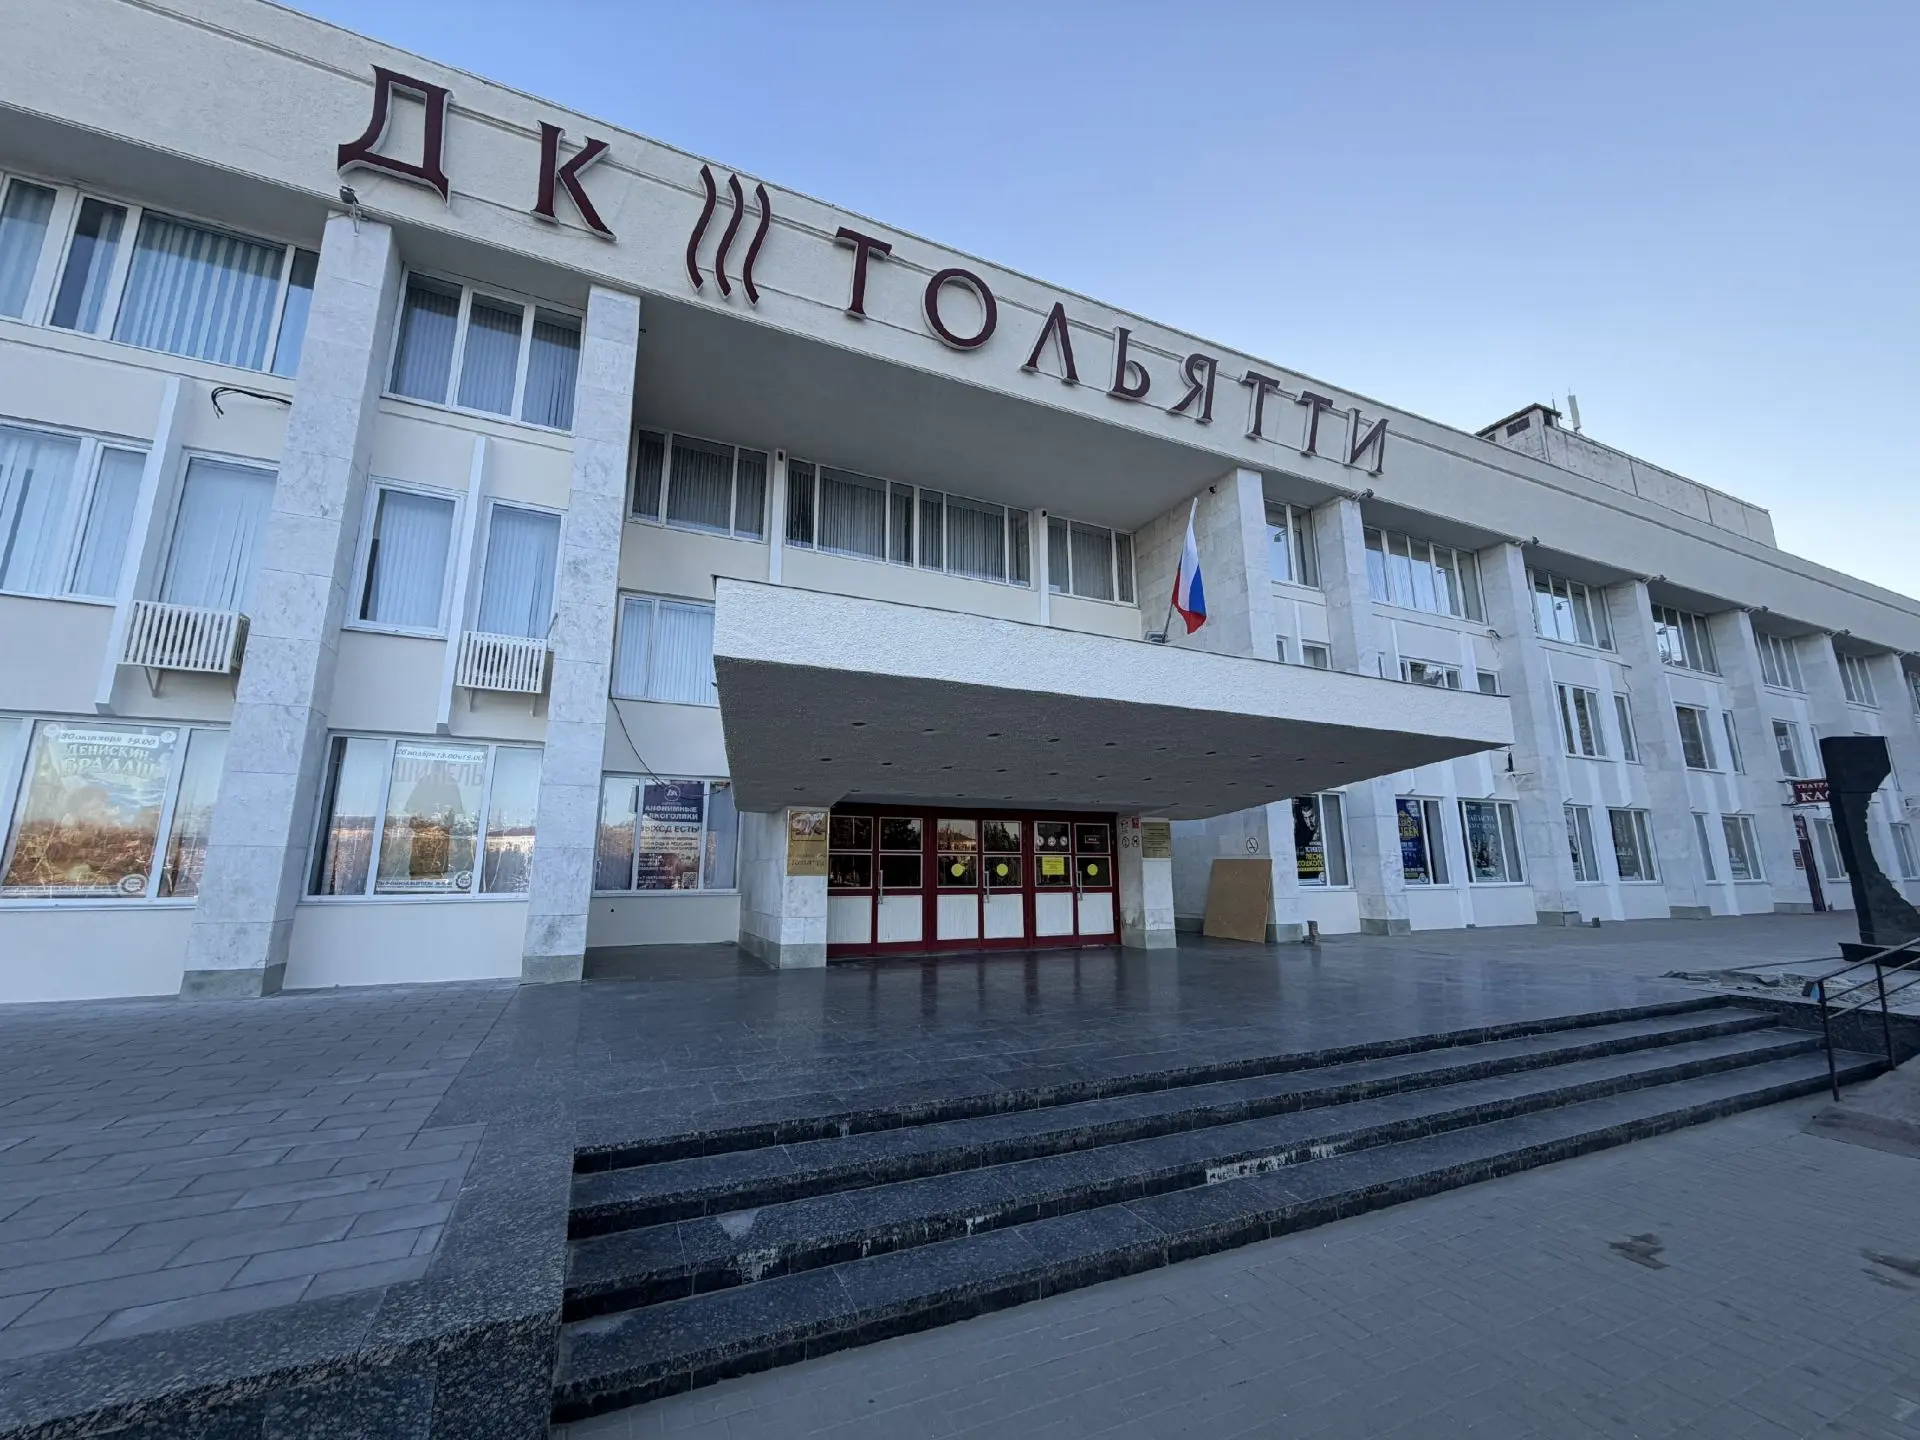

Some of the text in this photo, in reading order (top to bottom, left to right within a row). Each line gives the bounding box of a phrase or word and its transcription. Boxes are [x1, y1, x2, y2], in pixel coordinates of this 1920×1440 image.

[337, 64, 1391, 475] ДК ТОЛЬЯТТИ
[394, 760, 484, 786] ШИНЕЛЬ
[644, 805, 698, 813] АНОНИМНЫЕ
[640, 824, 673, 834] ВЫХОД
